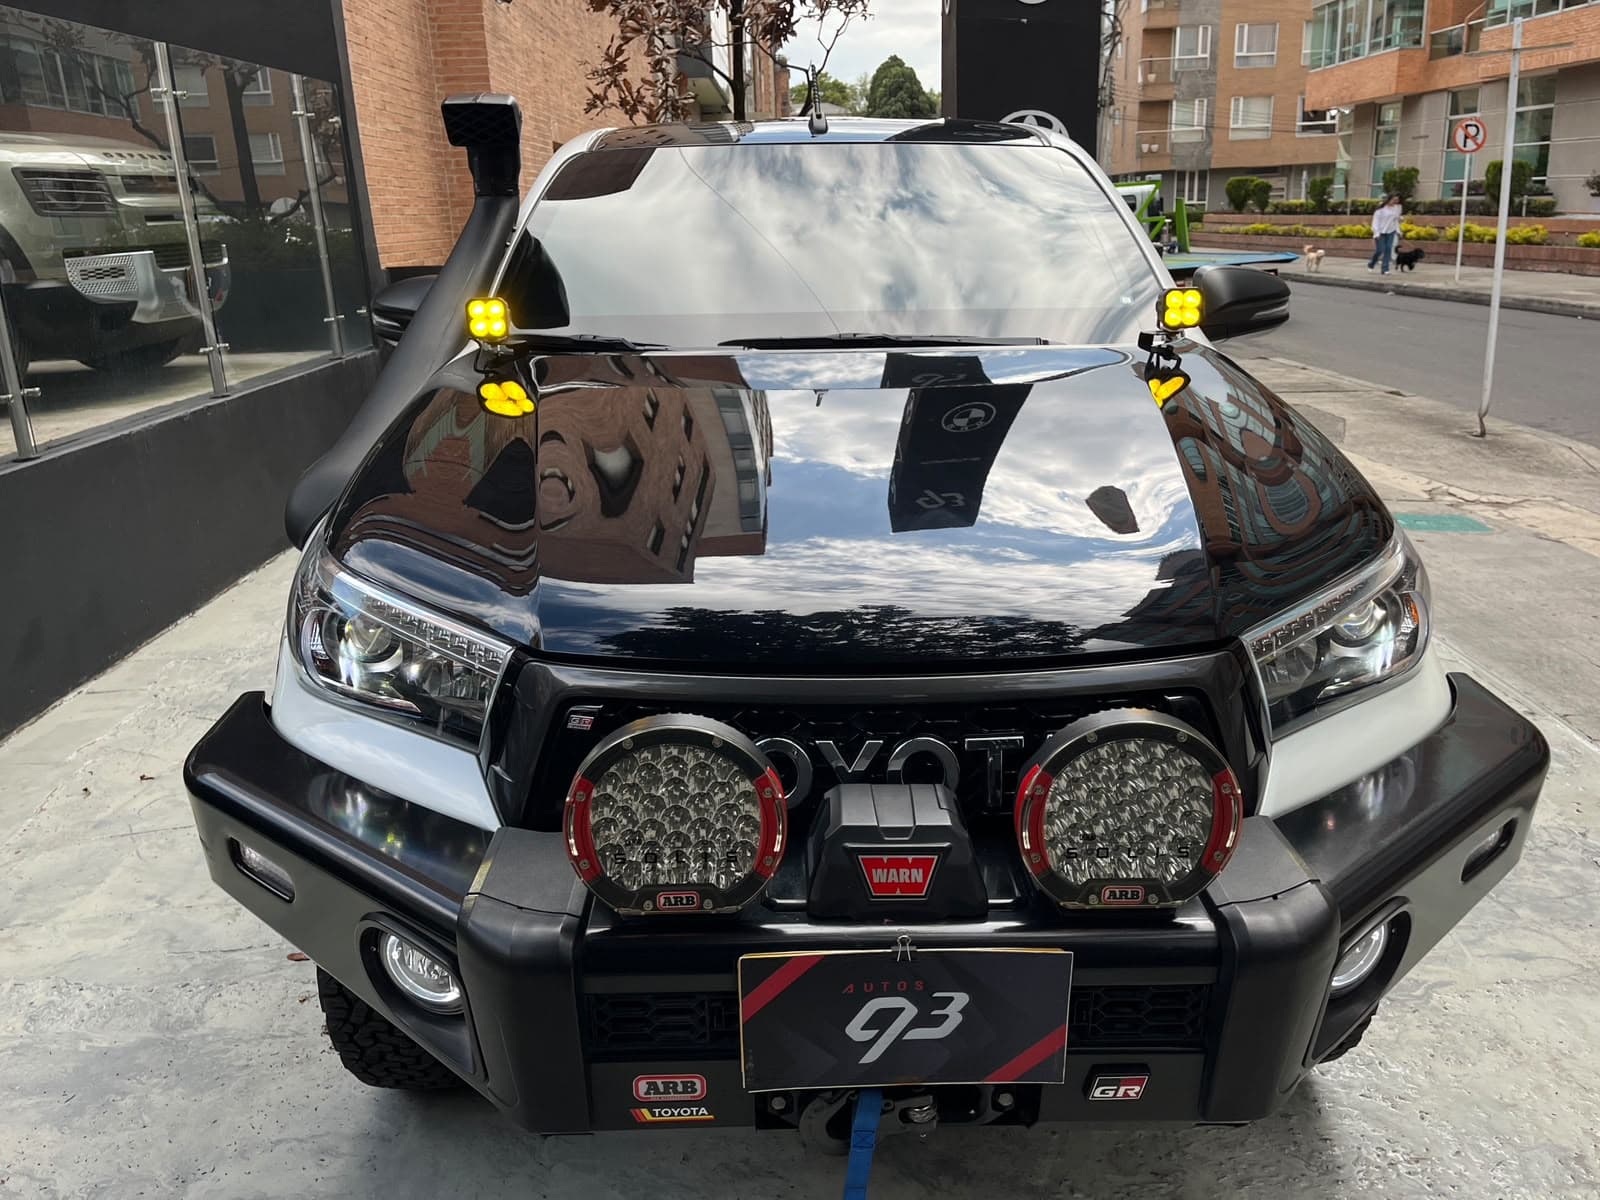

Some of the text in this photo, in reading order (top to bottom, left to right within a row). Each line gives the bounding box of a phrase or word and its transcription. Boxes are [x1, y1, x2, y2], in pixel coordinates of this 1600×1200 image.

[754, 736, 1053, 808] OYOT
[1065, 846, 1190, 859] SOLIS
[871, 867, 924, 884] WARN
[662, 895, 697, 907] ARB
[1106, 890, 1141, 900] ARB
[842, 980, 925, 994] AUTOS
[845, 991, 970, 1064] 93
[643, 1080, 698, 1096] ARB
[1093, 1085, 1141, 1098] GR
[652, 1106, 709, 1117] TOYOTA
